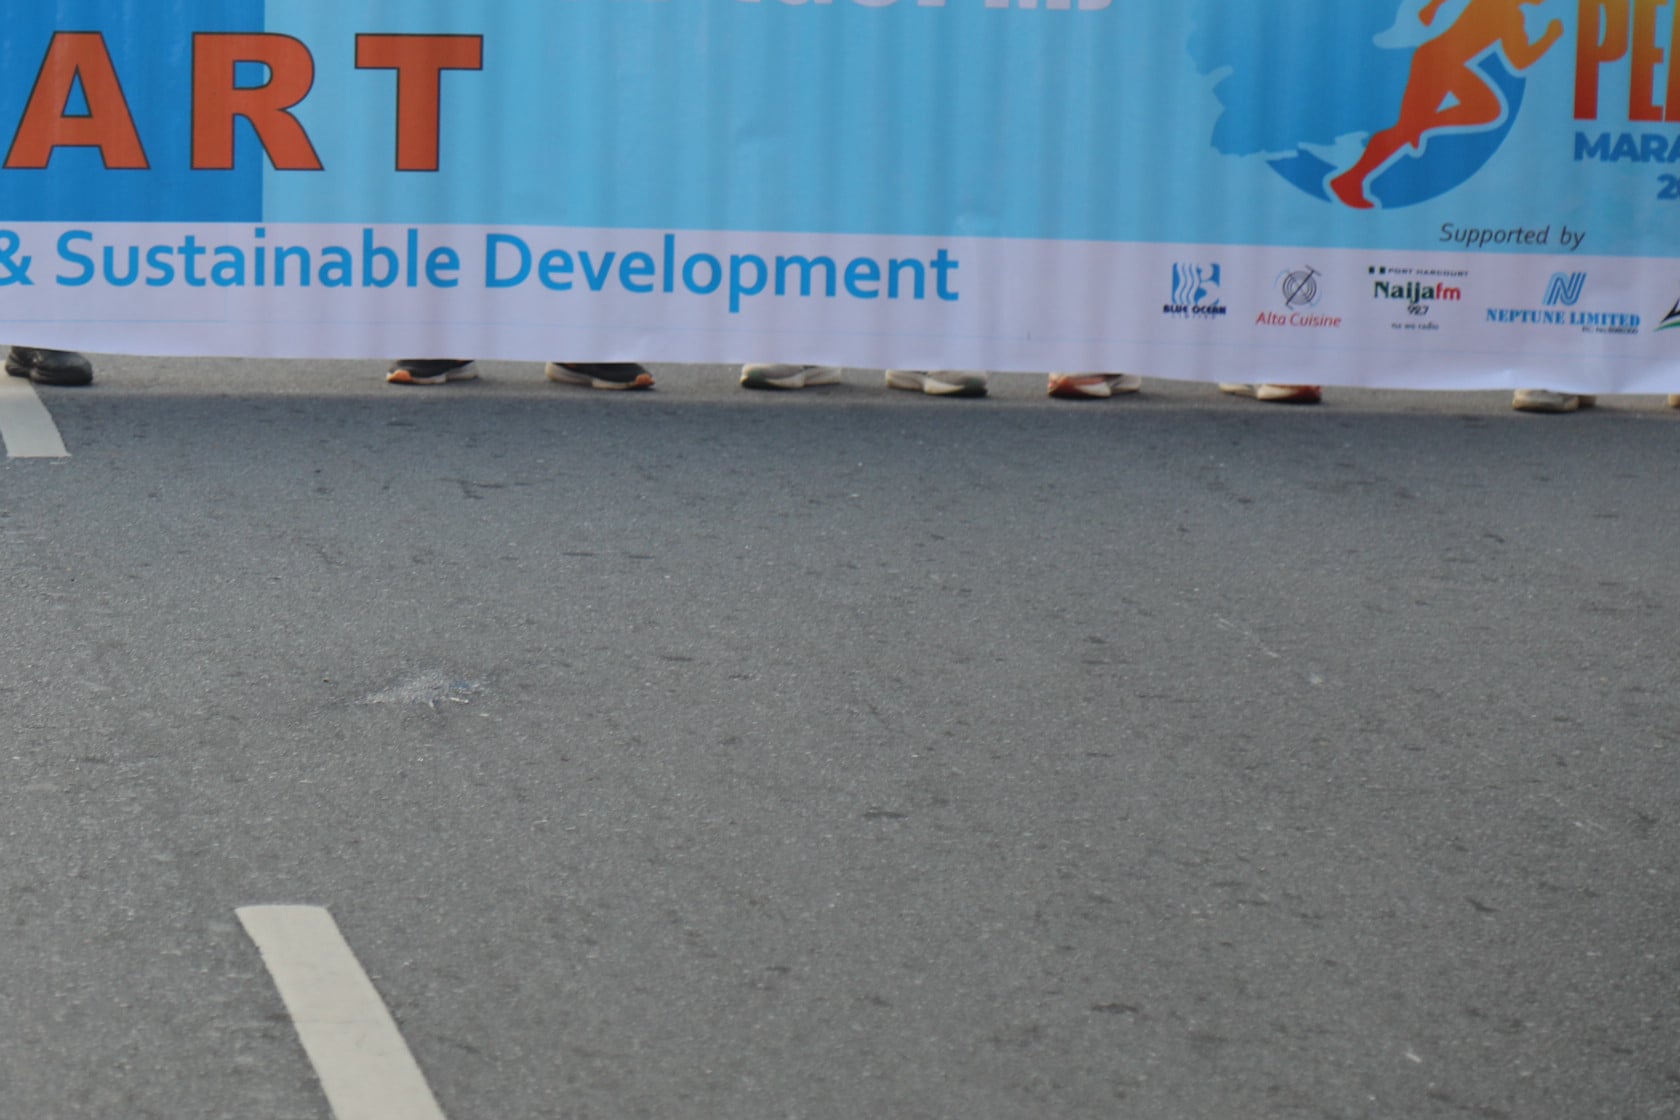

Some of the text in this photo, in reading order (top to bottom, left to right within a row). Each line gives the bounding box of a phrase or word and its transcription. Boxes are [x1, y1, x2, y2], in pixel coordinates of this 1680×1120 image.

[1439, 223, 1586, 251] Supported by
[55, 227, 461, 289] Sustainable
[484, 232, 960, 314] Development
[1255, 311, 1342, 327] Alta Cuisine
[1486, 308, 1641, 327] NEPTUNE LIMITED
